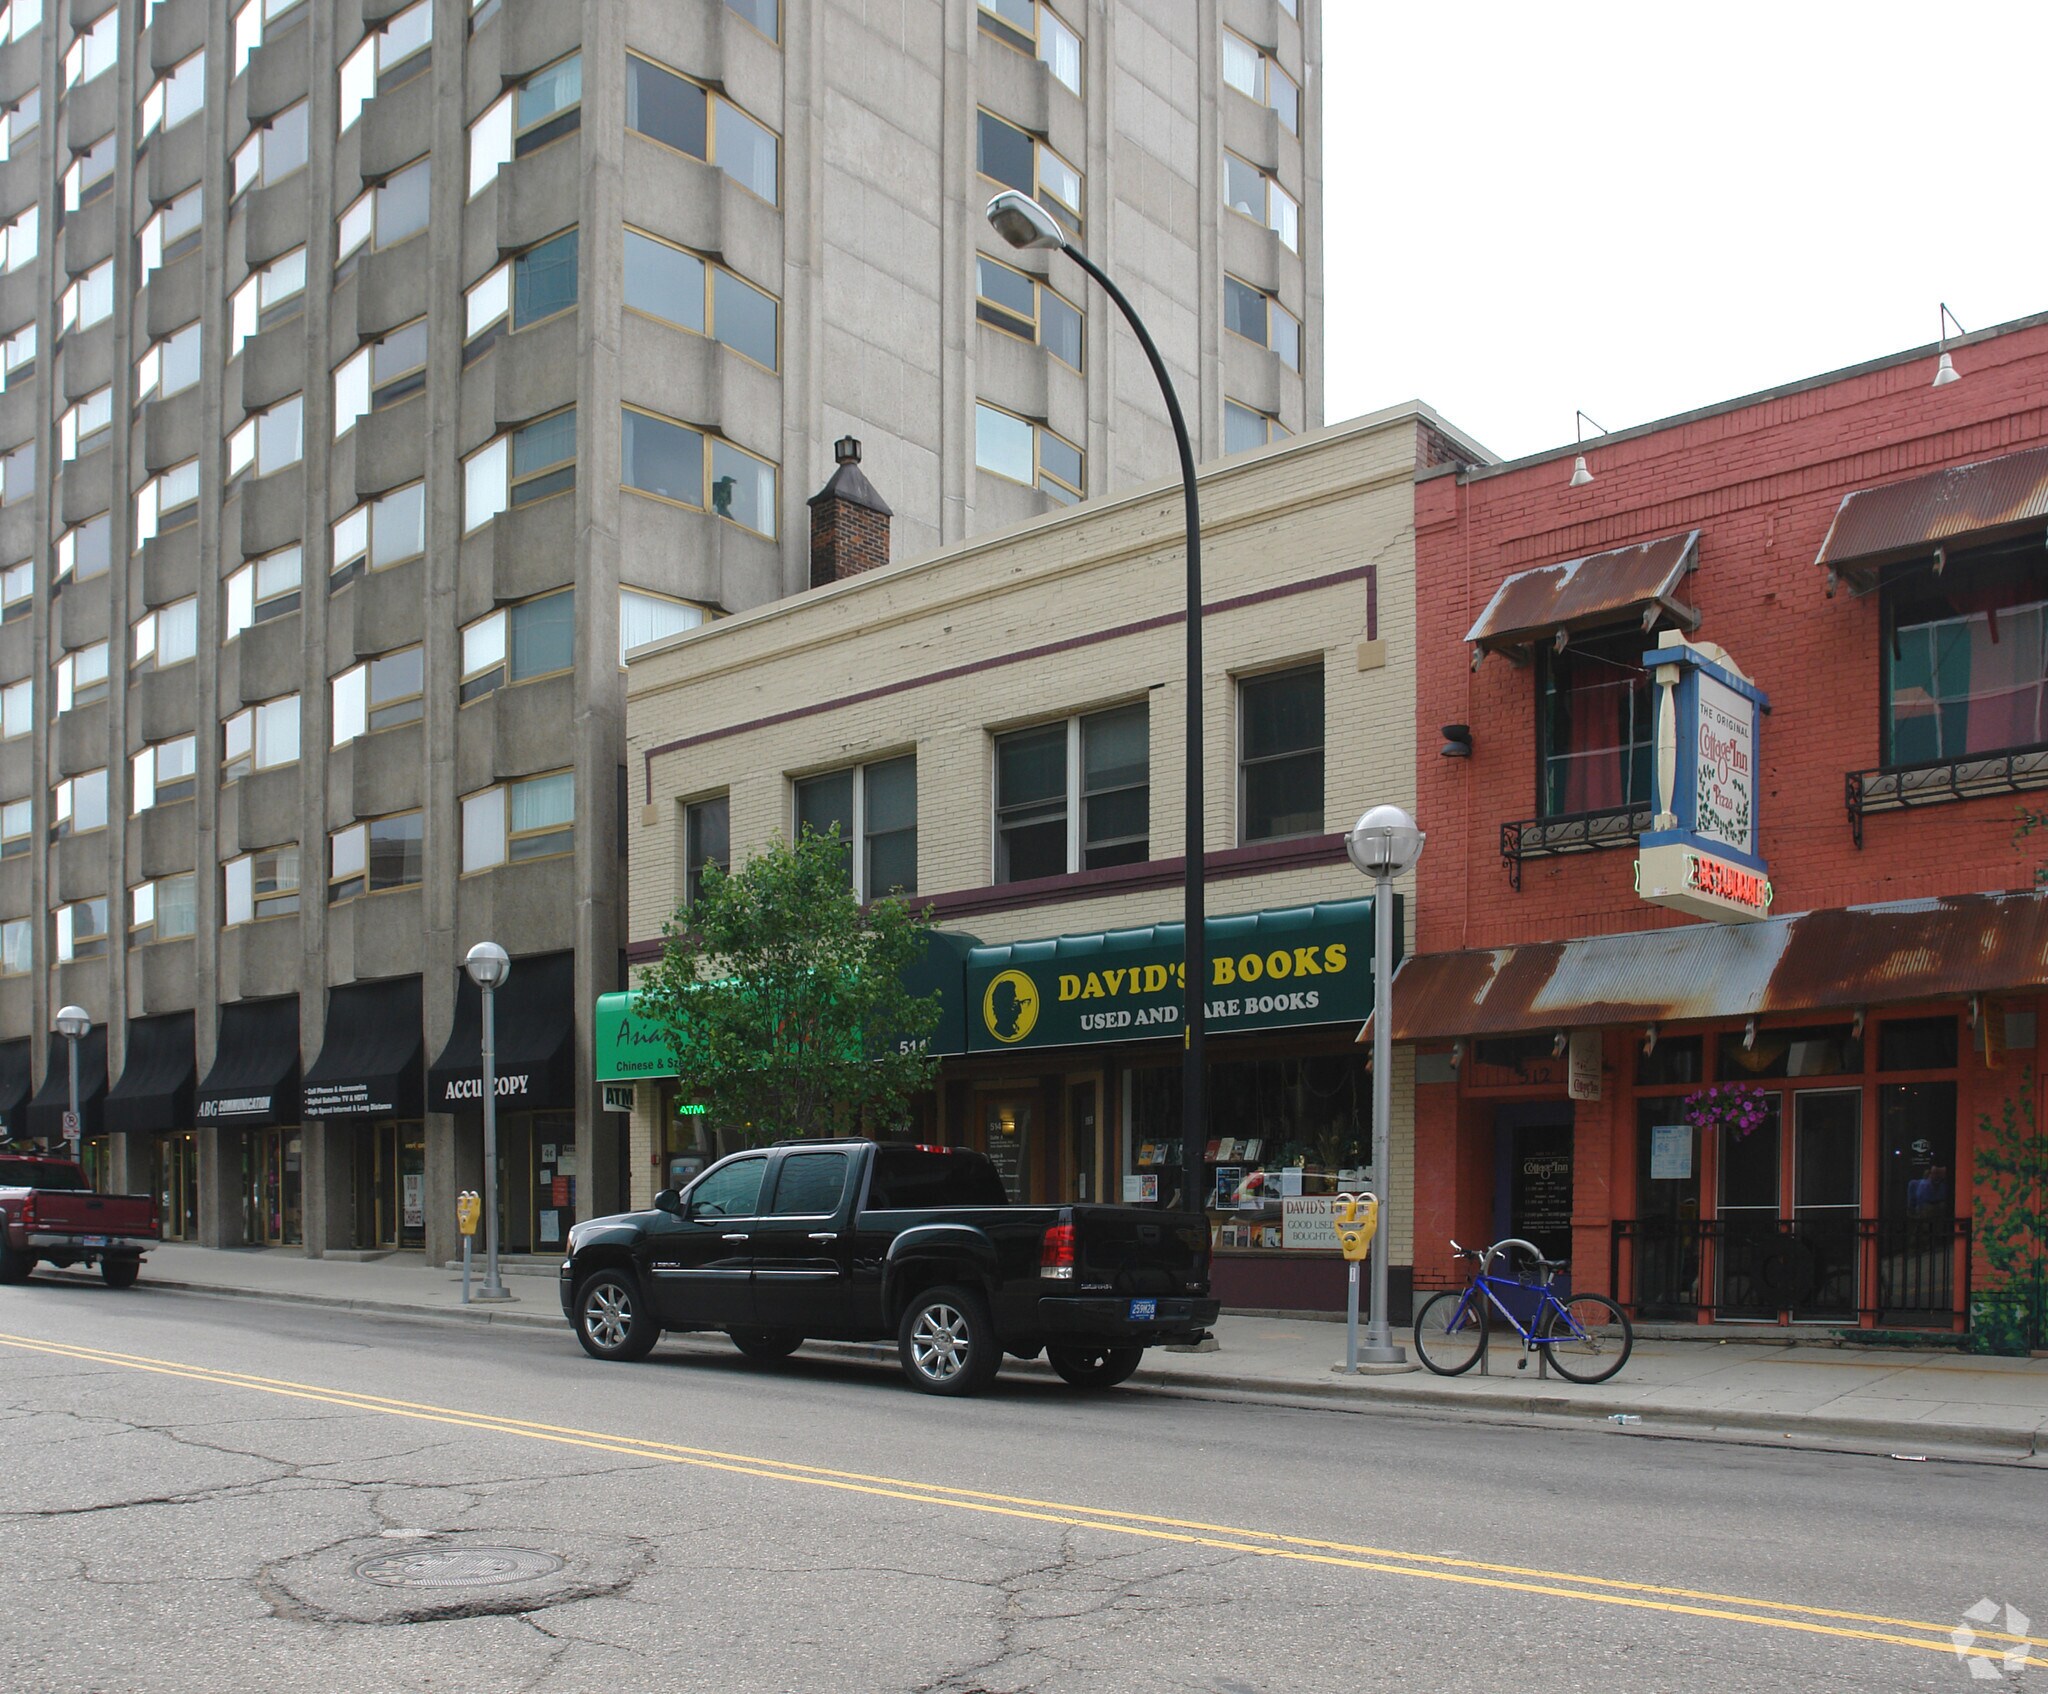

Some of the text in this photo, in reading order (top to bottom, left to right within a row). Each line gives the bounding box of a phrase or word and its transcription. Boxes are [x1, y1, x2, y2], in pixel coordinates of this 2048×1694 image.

[1700, 704, 1749, 738] THE ORIGINAL
[1700, 723, 1748, 785] Cottage Inn
[1212, 944, 1347, 986] BOOKS
[1080, 991, 1319, 1030] USED AND ARE BOOKS
[616, 1060, 653, 1072] Chinese
[657, 1058, 664, 1069] &
[445, 1079, 482, 1099] ACCU
[606, 1088, 633, 1106] ATM
[197, 1100, 218, 1117] ABG
[680, 1105, 705, 1115] ATM
[1286, 1200, 1326, 1215] DAVID'S
[1288, 1220, 1312, 1230] GOOD
[1293, 1231, 1327, 1240] BOUGHT
